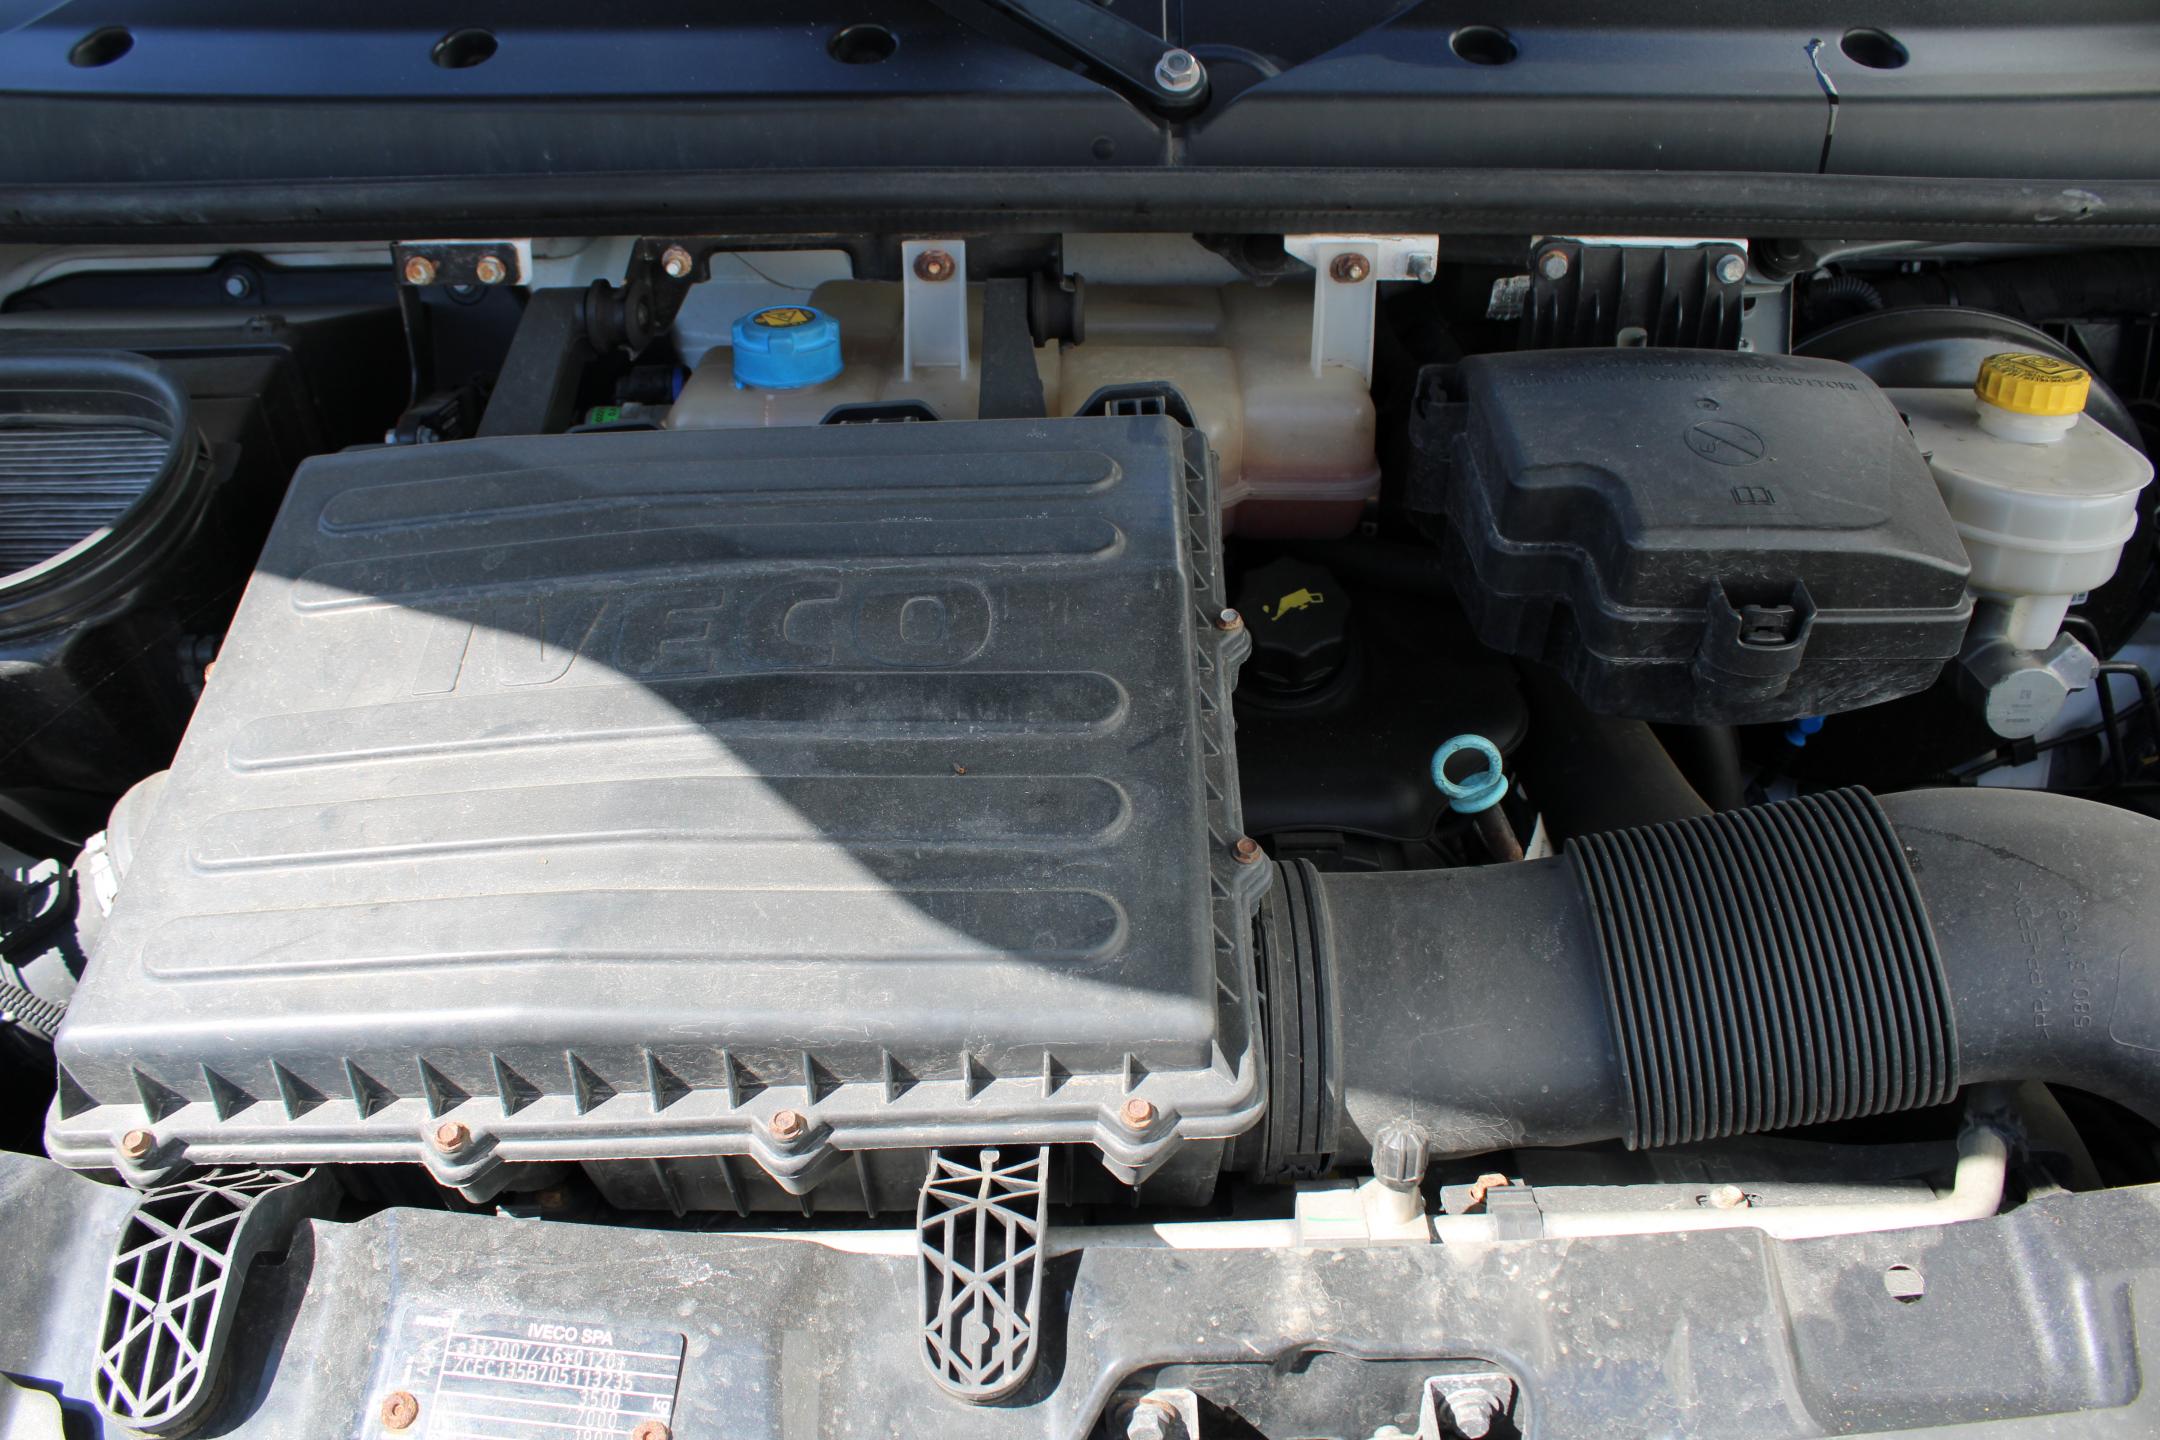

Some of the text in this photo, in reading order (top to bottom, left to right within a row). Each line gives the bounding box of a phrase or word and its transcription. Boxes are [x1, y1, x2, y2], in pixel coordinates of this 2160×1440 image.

[411, 577, 992, 695] IVECO
[527, 1322, 613, 1346] IVECO SPA
[579, 1387, 671, 1414] 3500 kg
